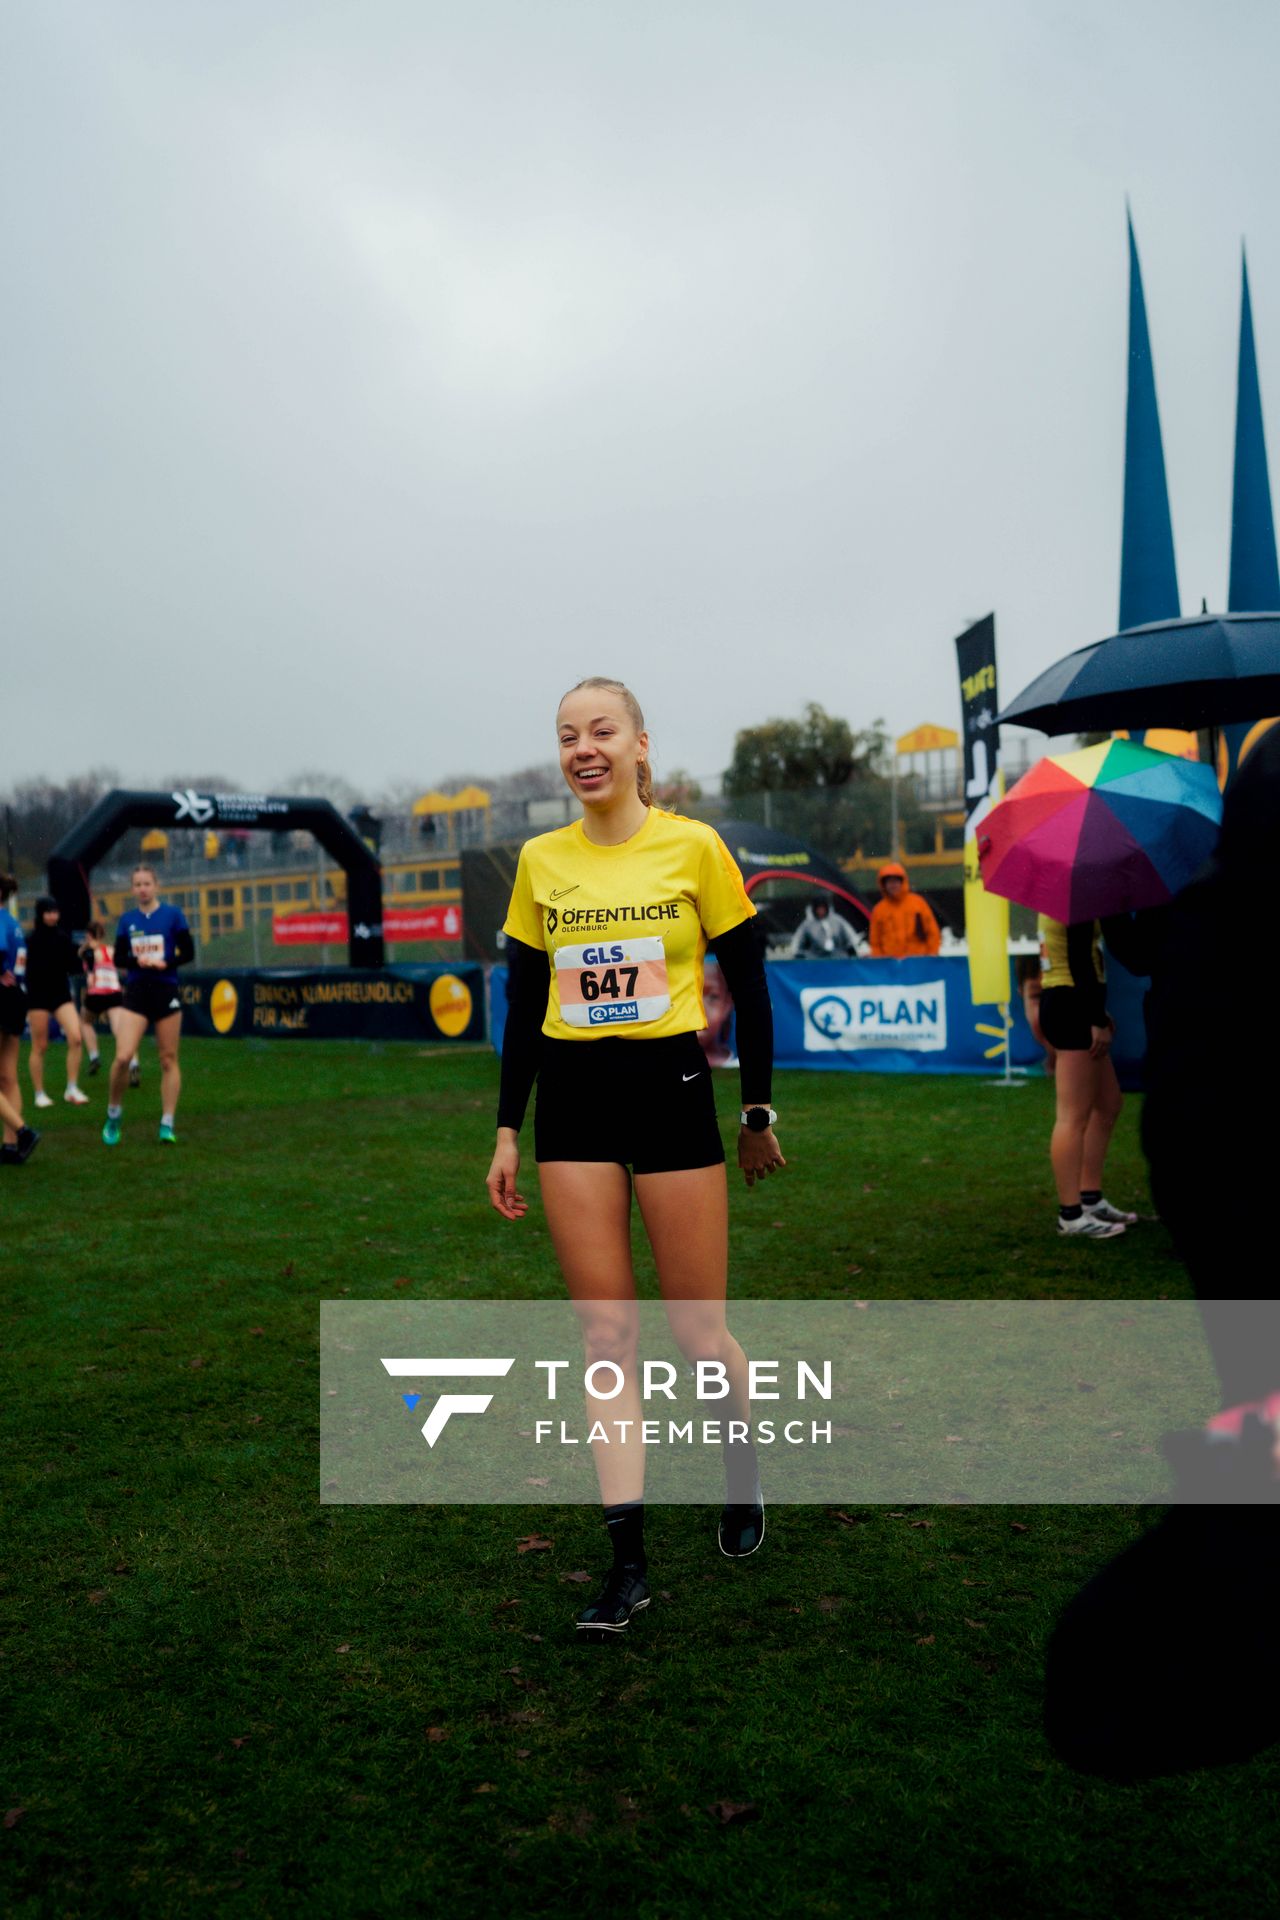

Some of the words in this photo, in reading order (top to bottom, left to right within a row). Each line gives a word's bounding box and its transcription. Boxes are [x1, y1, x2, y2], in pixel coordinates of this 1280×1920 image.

[562, 904, 680, 925] ÖFFENTLICHE
[562, 925, 608, 933] OLDENBURG
[580, 966, 639, 1001] 647
[608, 1005, 636, 1016] PLAN
[860, 999, 938, 1024] PLAN
